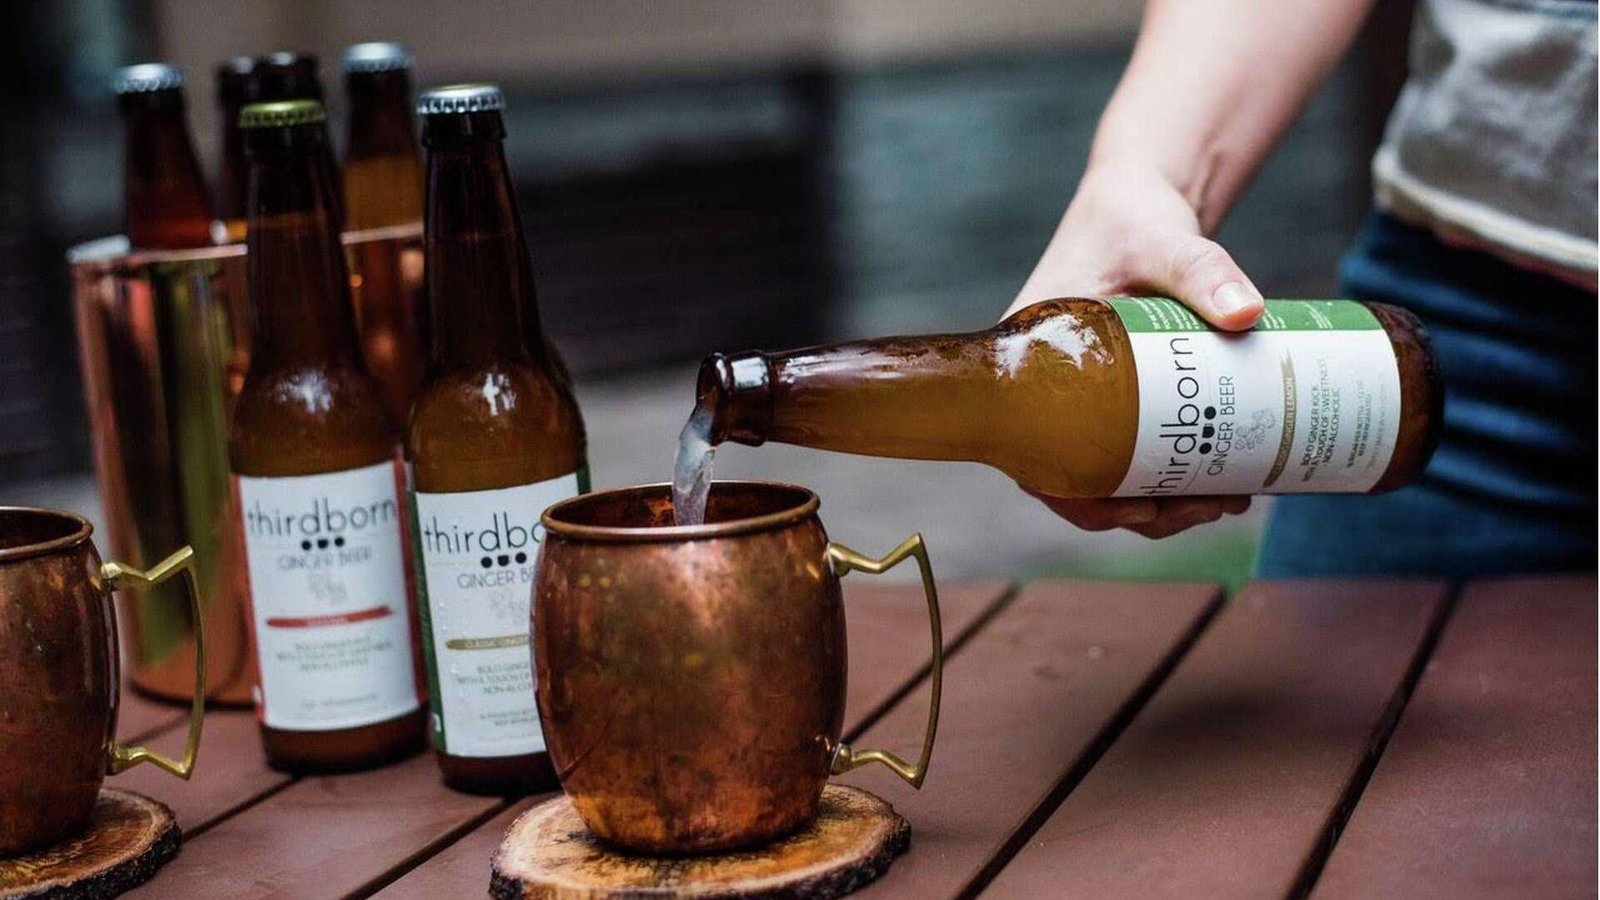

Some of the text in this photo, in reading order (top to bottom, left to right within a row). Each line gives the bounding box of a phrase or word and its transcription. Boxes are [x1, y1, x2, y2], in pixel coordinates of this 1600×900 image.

[1284, 377, 1295, 412] LEMON
[1140, 337, 1200, 495] thirdborn
[1207, 375, 1235, 476] GINGER BEER
[1283, 411, 1295, 446] GINGER
[1300, 384, 1320, 466] BOLD GINGER KICK
[1319, 414, 1329, 429] OF
[1321, 387, 1340, 464] NON-ALCOHOLIC
[1312, 429, 1327, 460] TOUCH
[247, 497, 397, 536] thirdborn
[457, 569, 515, 589] GINGER
